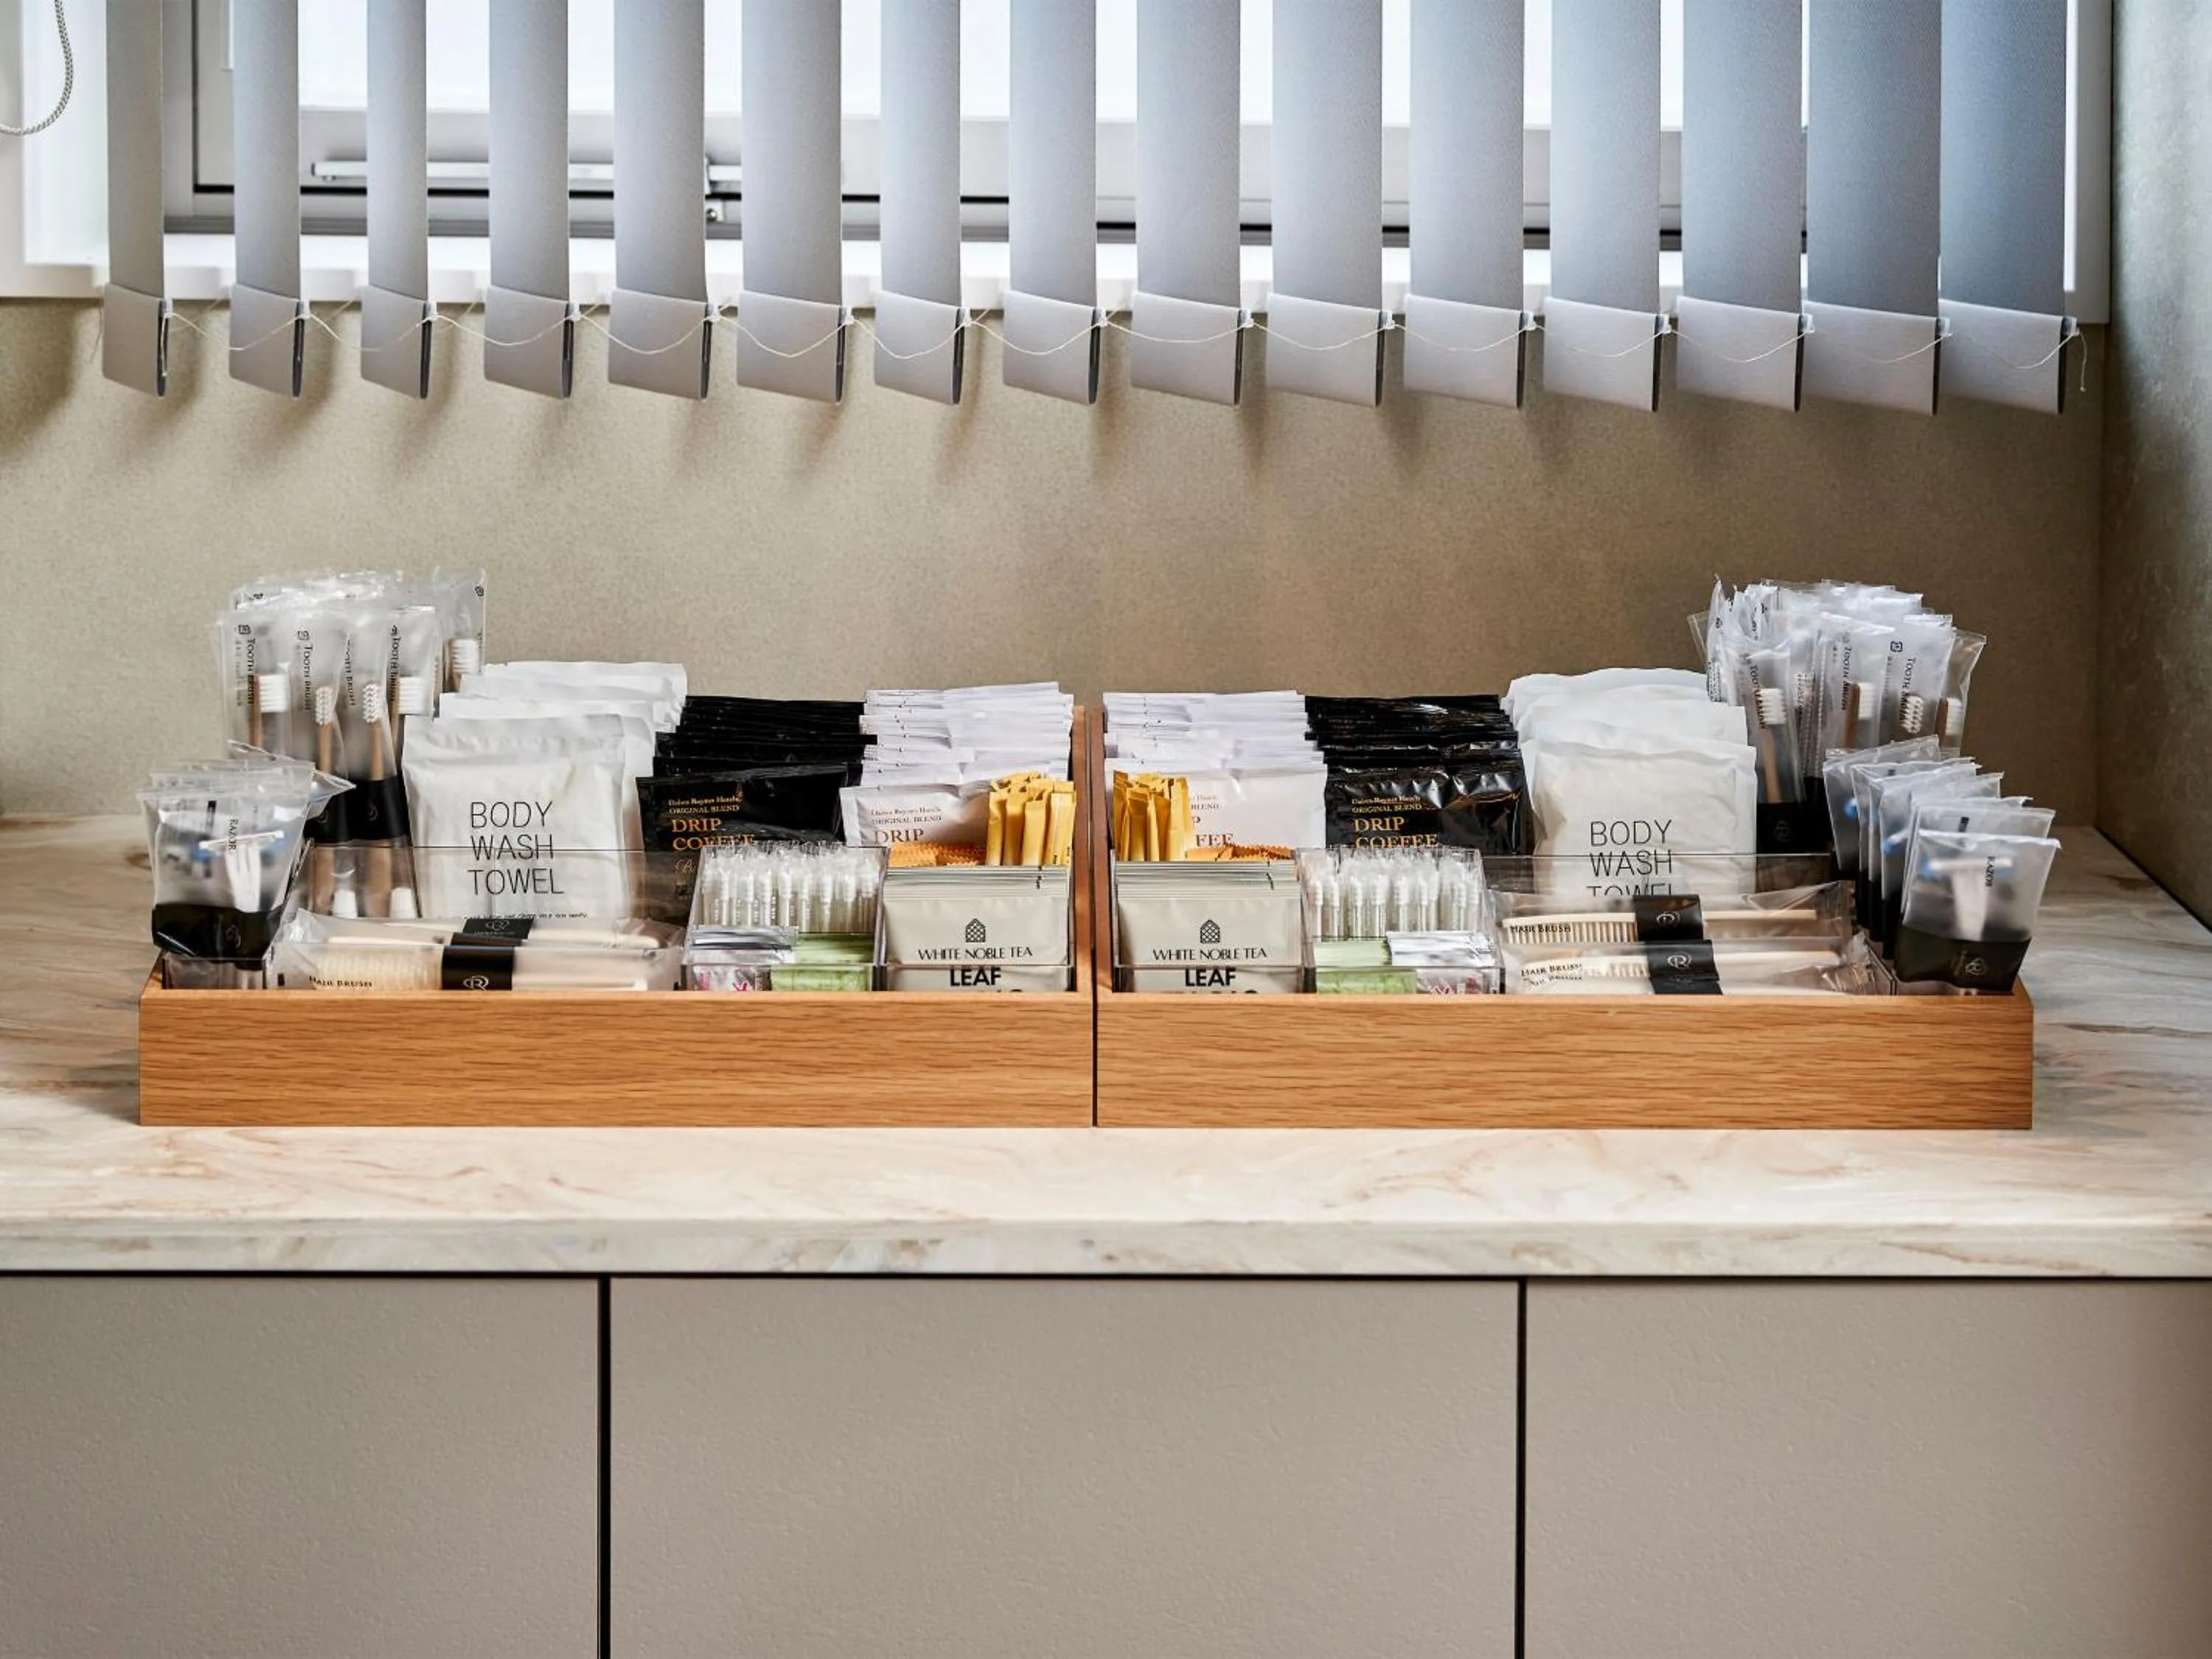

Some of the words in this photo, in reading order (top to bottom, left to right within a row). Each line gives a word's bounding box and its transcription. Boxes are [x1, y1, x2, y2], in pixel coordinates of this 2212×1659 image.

[470, 801, 553, 828] BODY
[1354, 816, 1405, 832] DRIP
[672, 817, 722, 833] DRIP
[1590, 818, 1672, 847] BODY
[872, 827, 925, 844] DRIP
[470, 833, 554, 861] WASH
[1589, 849, 1672, 877] WASH
[467, 868, 565, 895] TOWEL
[1509, 925, 1535, 933] HAIR
[1537, 922, 1571, 933] BRUSH
[918, 948, 961, 961] WHITE
[965, 947, 1005, 960] NOBLE
[1009, 946, 1033, 957] TEA
[1152, 948, 1195, 961] WHITE
[1200, 947, 1239, 960] NOBLE
[1243, 947, 1267, 959] TEA
[950, 967, 1002, 987] LEAF
[1184, 967, 1237, 987] LEAF
